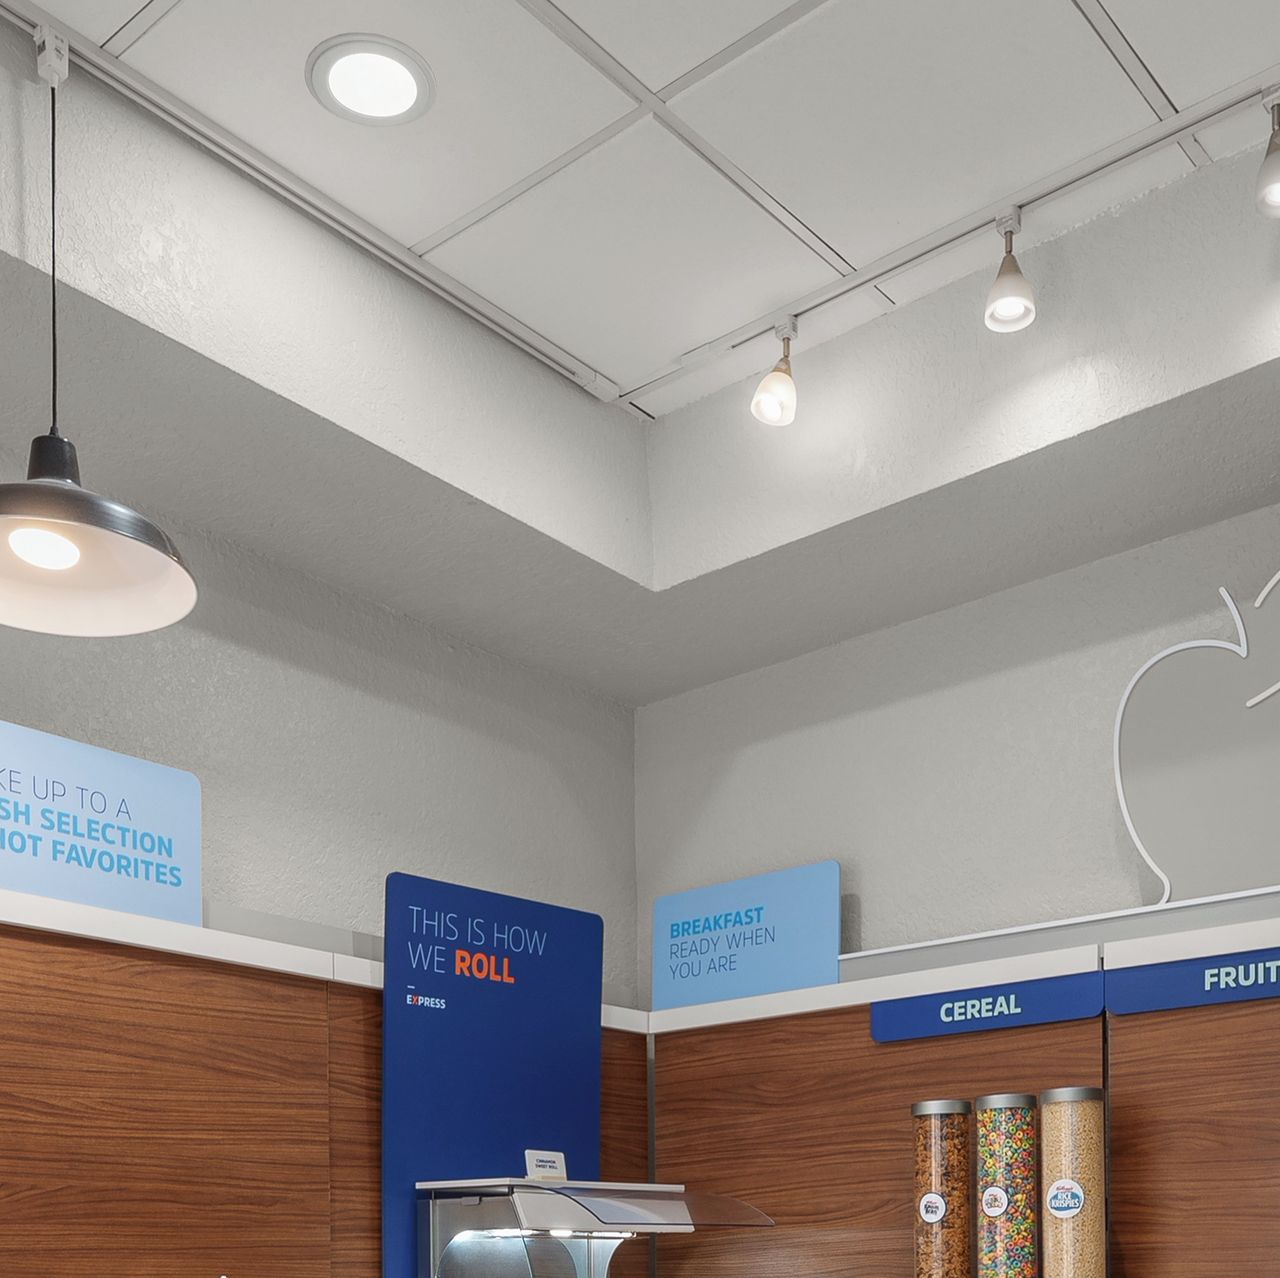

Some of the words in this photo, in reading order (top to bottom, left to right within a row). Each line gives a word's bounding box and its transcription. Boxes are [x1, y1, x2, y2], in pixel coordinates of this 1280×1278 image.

[32, 776, 66, 802] UP
[76, 787, 106, 814] TO
[116, 799, 132, 821] A
[41, 808, 173, 860] SELECTION
[51, 840, 182, 887] FAVORITES
[409, 906, 458, 940] THIS
[468, 918, 485, 945] IS
[494, 923, 546, 955] HOW
[671, 906, 764, 939] BREAKFAST
[670, 936, 720, 959] READY
[726, 926, 775, 949] WHEN
[408, 941, 445, 973] WE
[455, 949, 515, 983] ROLL
[670, 960, 702, 979] YOU
[707, 954, 736, 974] ARE
[1205, 960, 1280, 990] FRUIT
[407, 995, 445, 1009] EXPRESS
[940, 994, 1021, 1022] CEREAL
[1051, 1199, 1080, 1208] KRISPIES
[1058, 1191, 1072, 1200] RICE
